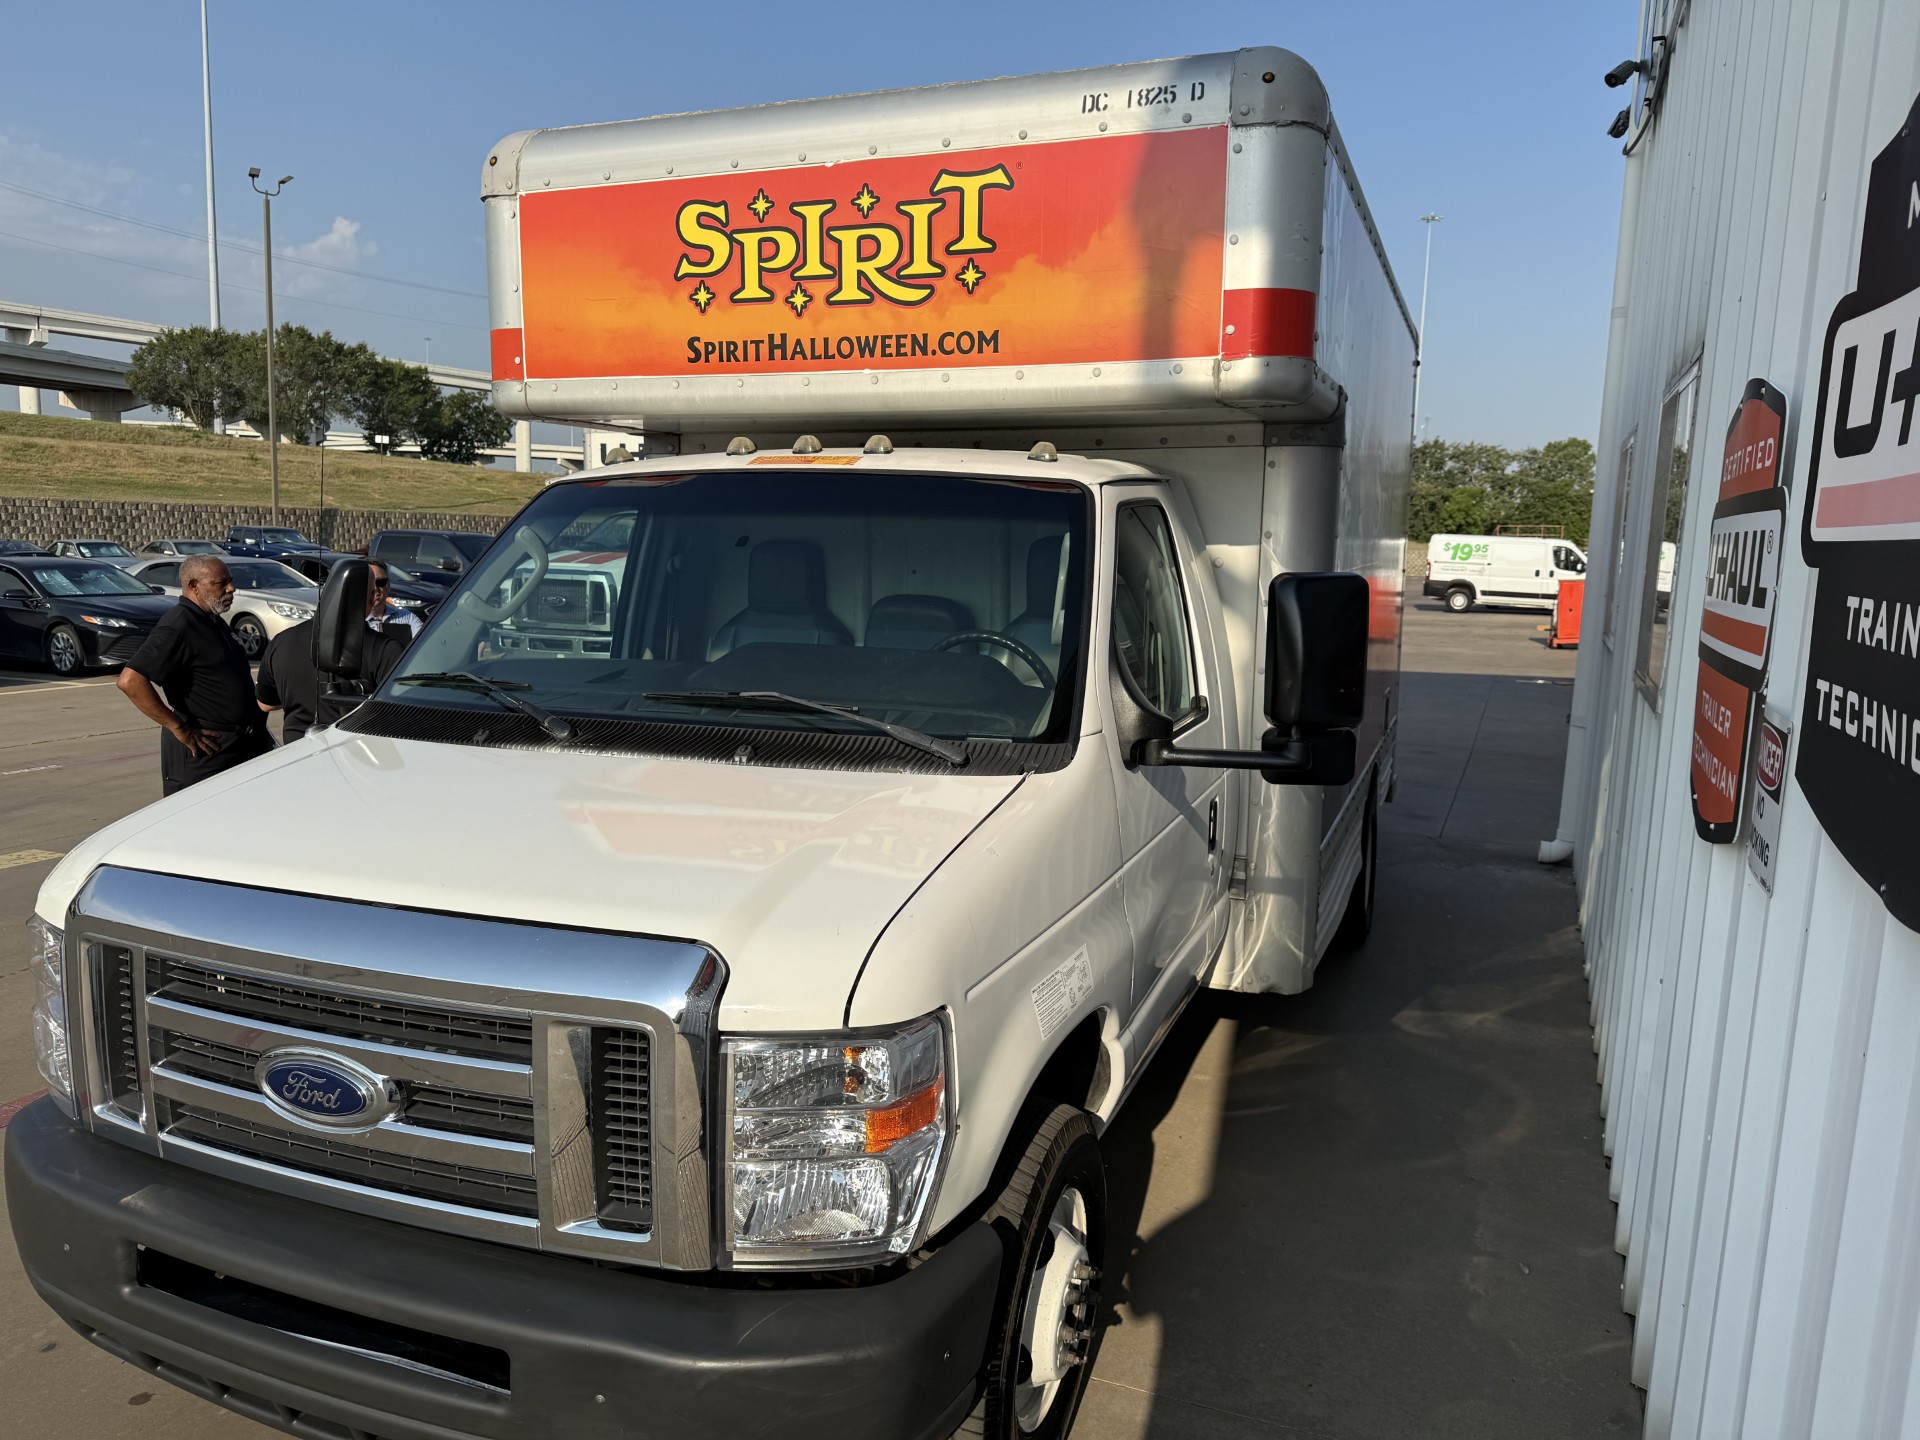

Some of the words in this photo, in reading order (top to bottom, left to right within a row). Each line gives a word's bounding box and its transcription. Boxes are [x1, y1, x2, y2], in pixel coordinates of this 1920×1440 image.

[1081, 93, 1108, 114] DC
[1190, 81, 1205, 101] D
[674, 163, 1014, 306] SPIRIT
[1723, 437, 1774, 482] CERTIFIED
[1702, 690, 1731, 738] TRAILER
[1694, 731, 1736, 802] TECHNICIAN
[282, 1070, 341, 1109] Ford
